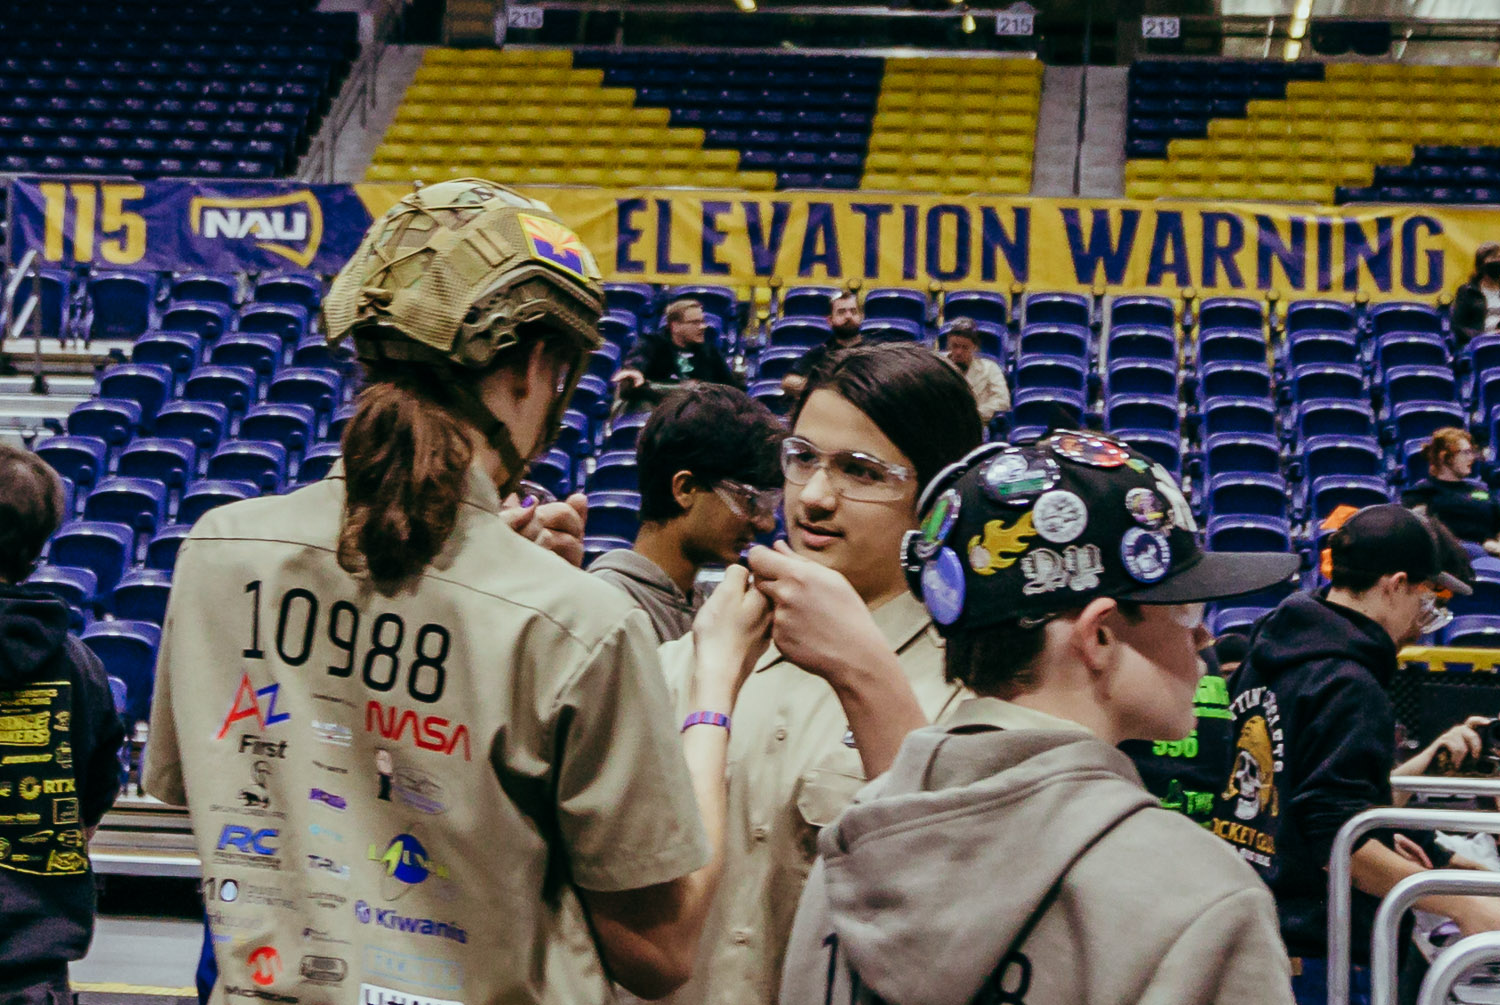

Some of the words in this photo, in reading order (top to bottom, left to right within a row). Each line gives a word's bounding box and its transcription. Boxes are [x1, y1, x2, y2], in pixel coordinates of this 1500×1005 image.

[999, 17, 1031, 34] 215
[1146, 19, 1178, 36] 213
[40, 182, 147, 265] 115
[203, 209, 307, 240] NAU
[615, 197, 1031, 283] ELEVATION
[1059, 207, 1445, 295] WARNING
[241, 579, 451, 704] 10988
[365, 700, 472, 763] NASA
[43, 779, 76, 794] RTX
[217, 824, 281, 856] RC
[375, 906, 468, 945] Kiwanis
